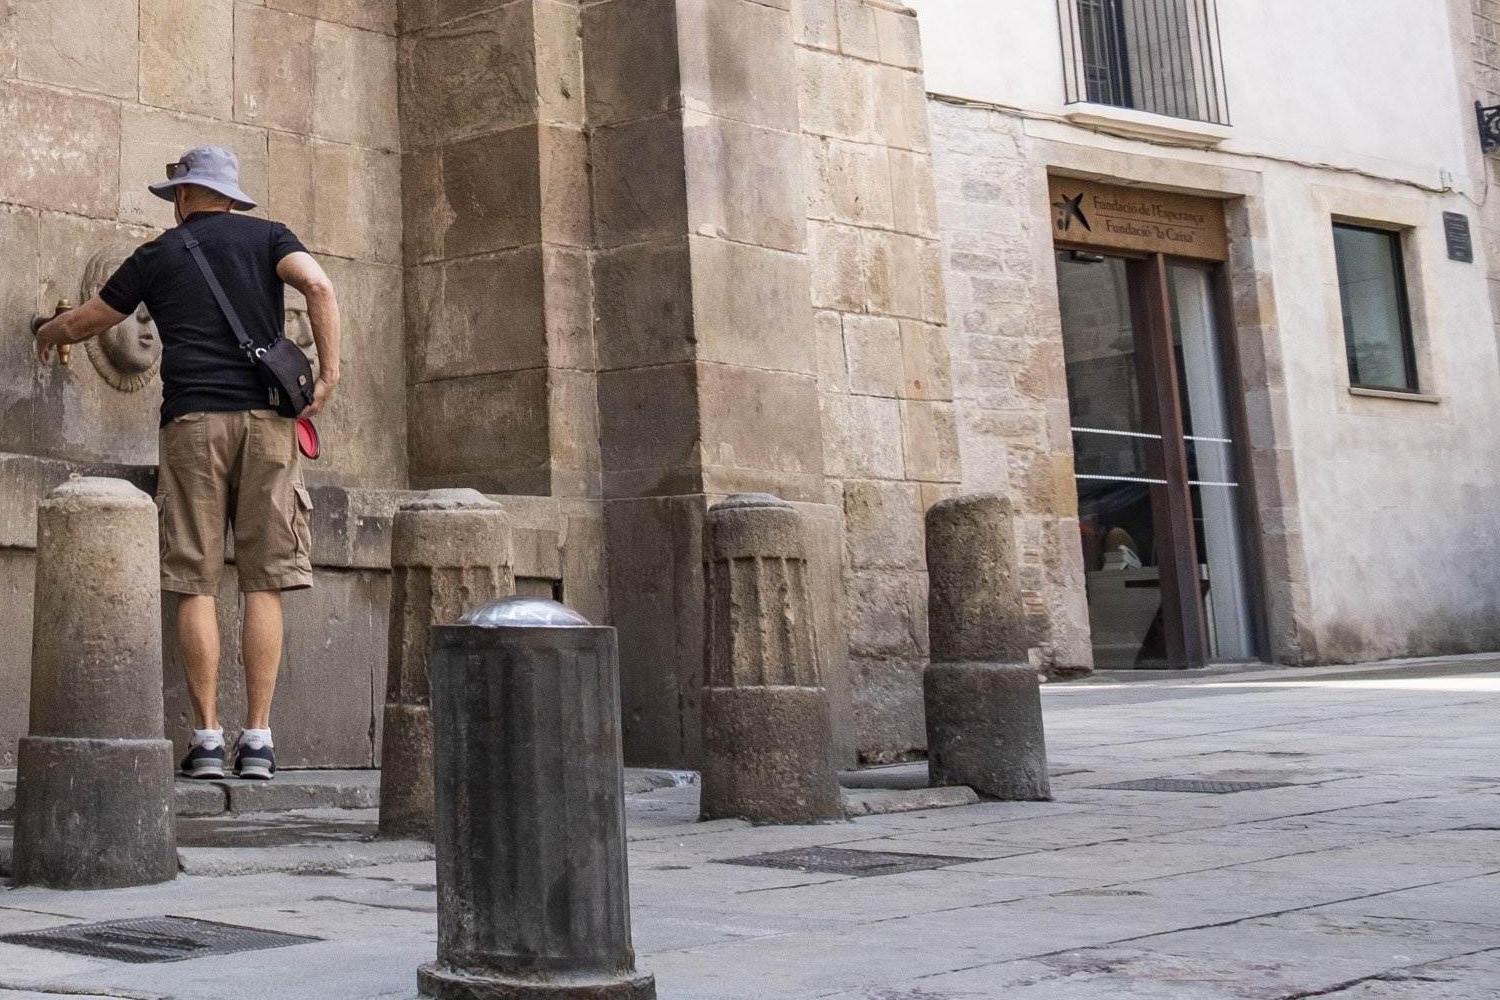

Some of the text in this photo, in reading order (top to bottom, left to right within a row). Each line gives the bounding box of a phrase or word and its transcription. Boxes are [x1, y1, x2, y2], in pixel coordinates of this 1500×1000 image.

[1094, 196, 1139, 214] Fundació
[1140, 204, 1151, 216] de
[1106, 220, 1150, 238] Fundació
